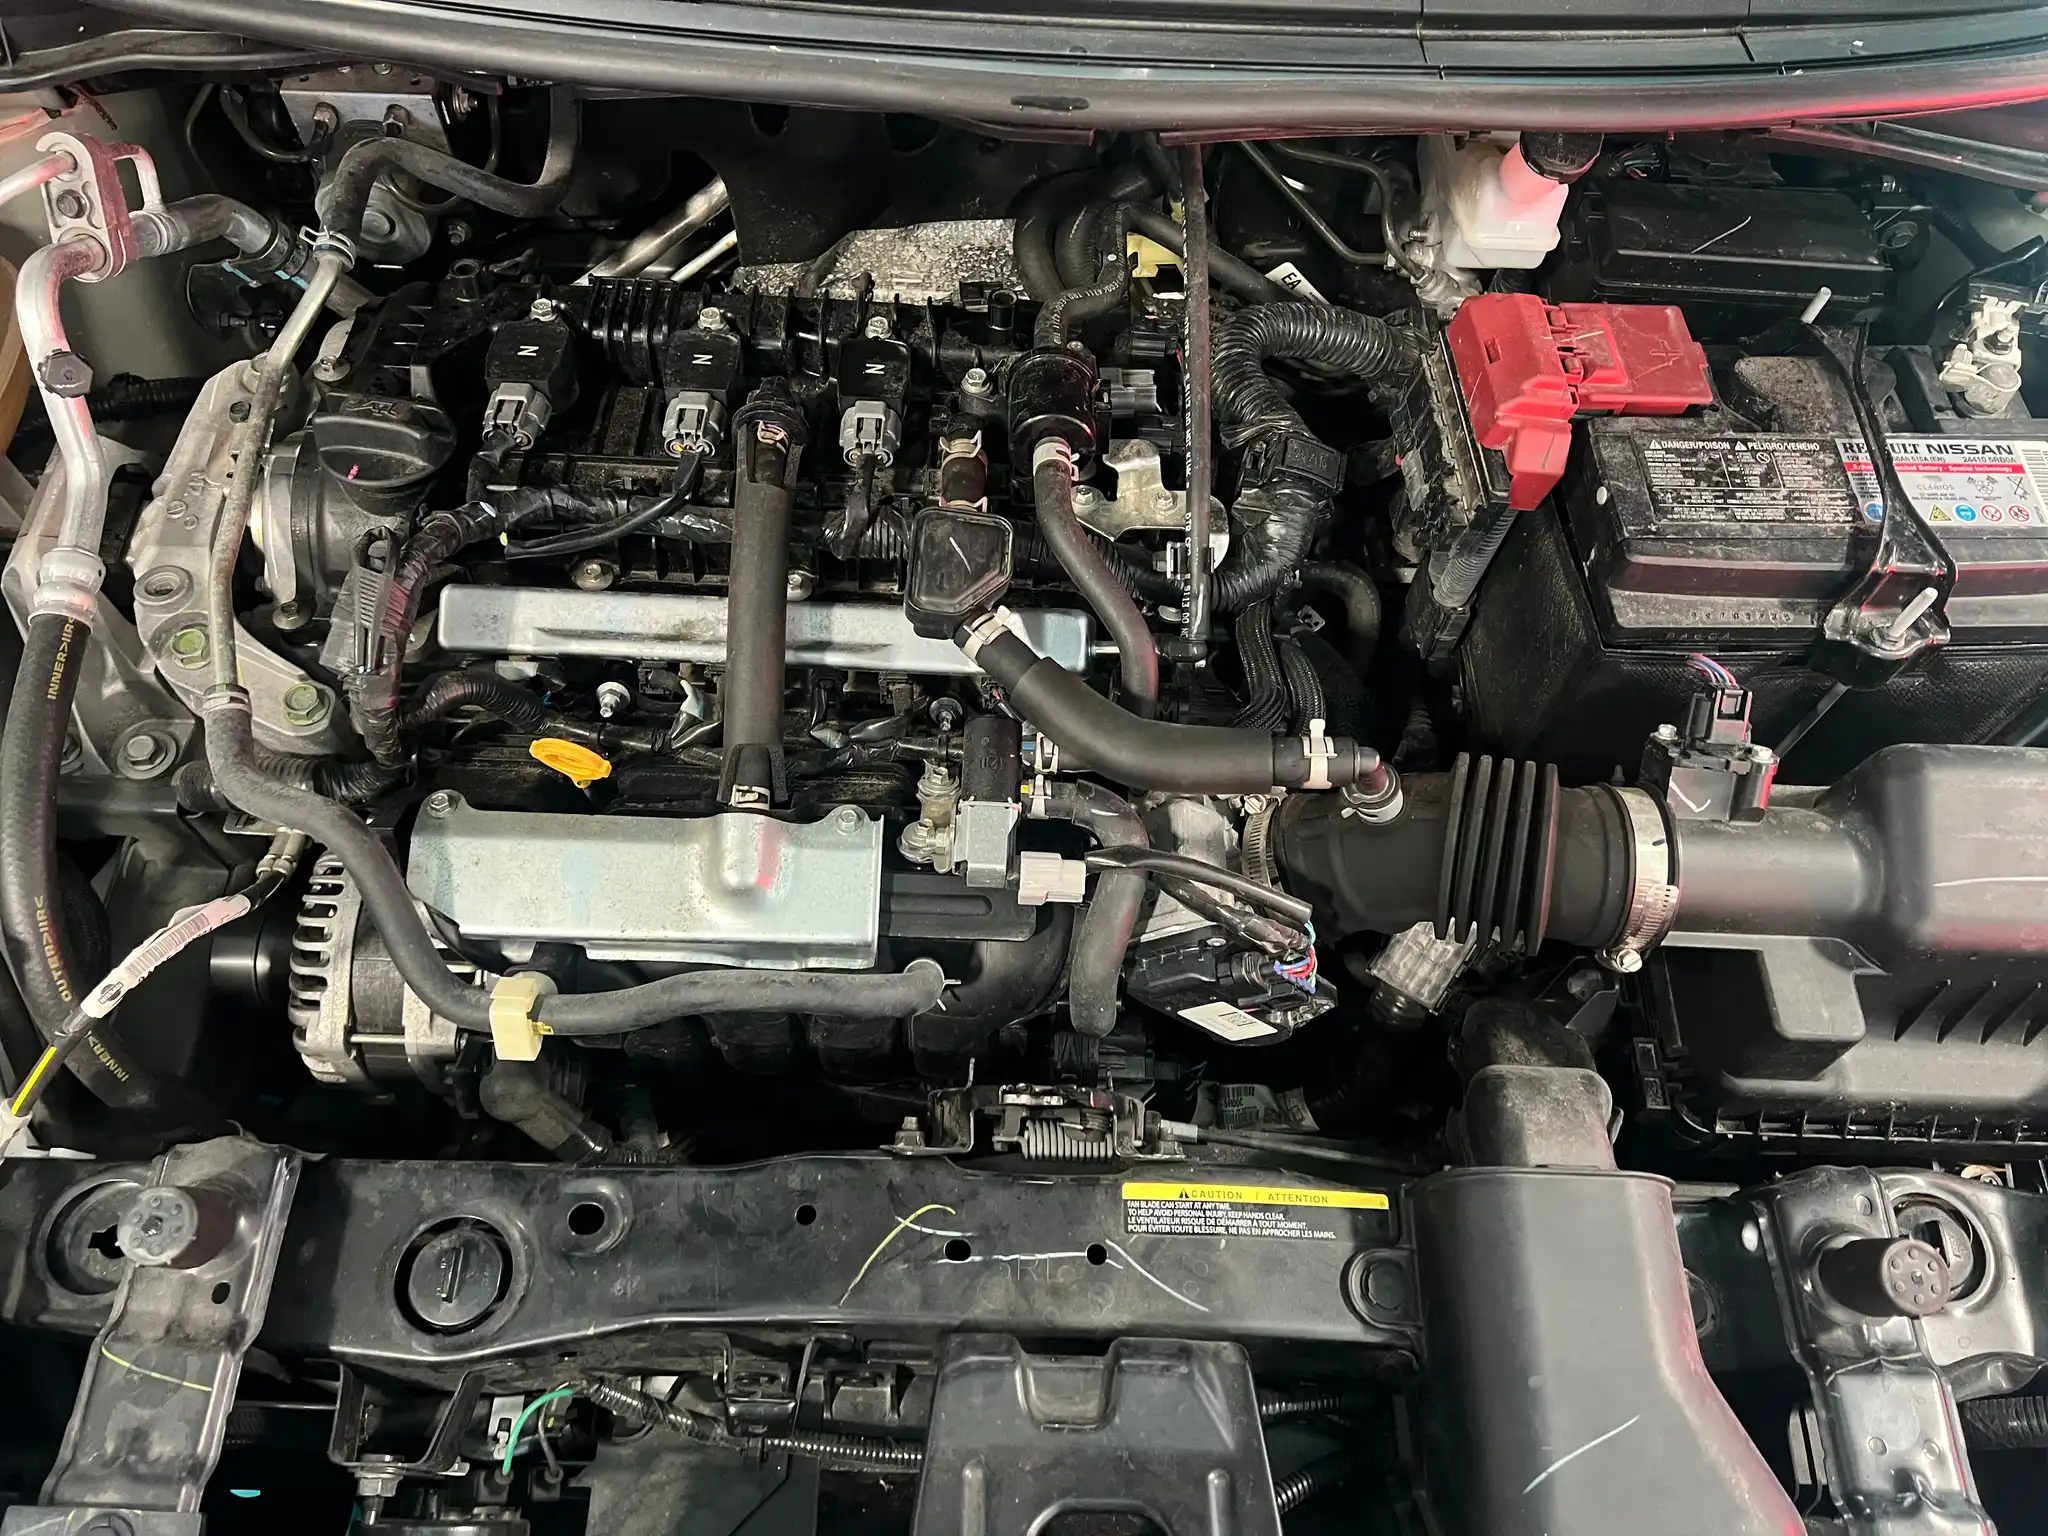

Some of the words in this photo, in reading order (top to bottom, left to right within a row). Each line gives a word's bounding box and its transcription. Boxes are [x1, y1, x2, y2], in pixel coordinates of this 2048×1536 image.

[1661, 441, 1731, 450] DANGER/POISON
[1747, 442, 1820, 451] PELIGRO/VENENO
[1842, 442, 1920, 454] REULT
[1927, 443, 2014, 455] NISSAN
[1191, 1189, 1242, 1199] CAUTION
[1268, 1193, 1328, 1203] ATTENTION
[1127, 1200, 1139, 1208] FAN
[1161, 1201, 1174, 1209] CAN
[1175, 1201, 1193, 1209] START
[1153, 1209, 1173, 1217] AVOID
[1174, 1209, 1205, 1217] PERSONAL
[1228, 1210, 1242, 1218] KEEP
[1243, 1211, 1264, 1220] HANDS
[1265, 1212, 1285, 1220] CLEAR.
[1128, 1216, 1136, 1224] LE
[1136, 1217, 1181, 1225] VENTILATEUR
[1181, 1218, 1205, 1226] RISQUE
[1206, 1218, 1216, 1226] DE
[1258, 1220, 1276, 1228] TOUT
[1277, 1220, 1308, 1229] MOMENT.
[1171, 1225, 1193, 1233] TOUTE
[1239, 1227, 1251, 1235] PAS
[1262, 1228, 1301, 1237] APPROCHER
[1313, 1230, 1336, 1238] MAINS.
